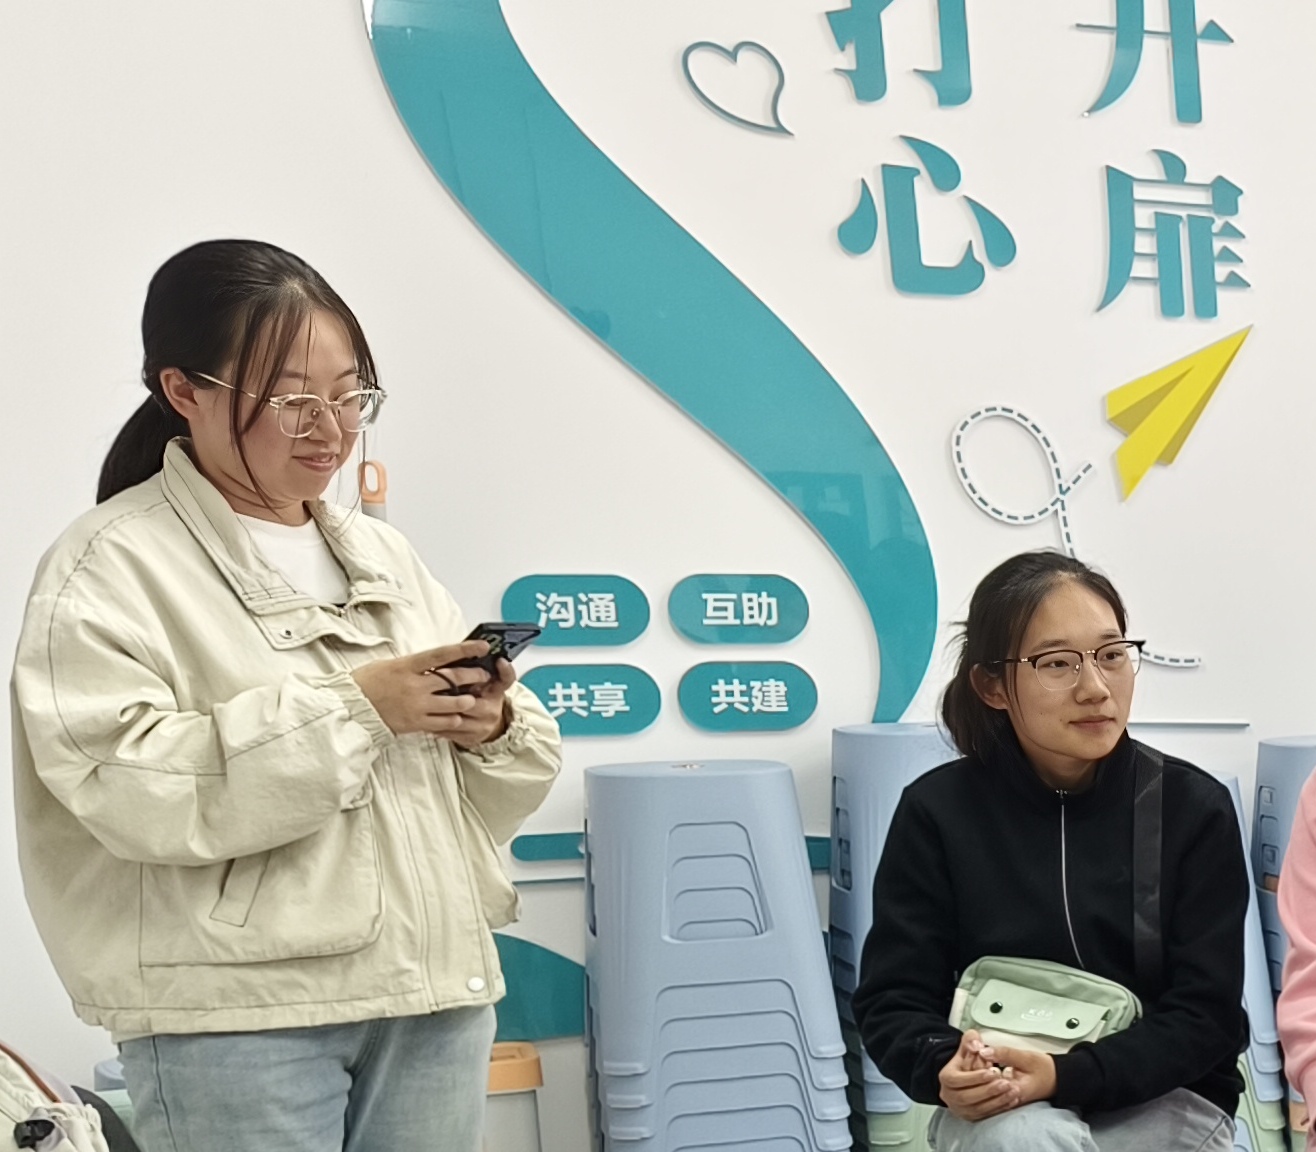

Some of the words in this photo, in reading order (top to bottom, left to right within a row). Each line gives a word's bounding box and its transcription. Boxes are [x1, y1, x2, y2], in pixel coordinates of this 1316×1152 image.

[535, 592, 619, 629] 沟通
[701, 591, 779, 627] 互助
[548, 681, 630, 717] 共享
[711, 678, 789, 713] 共建
